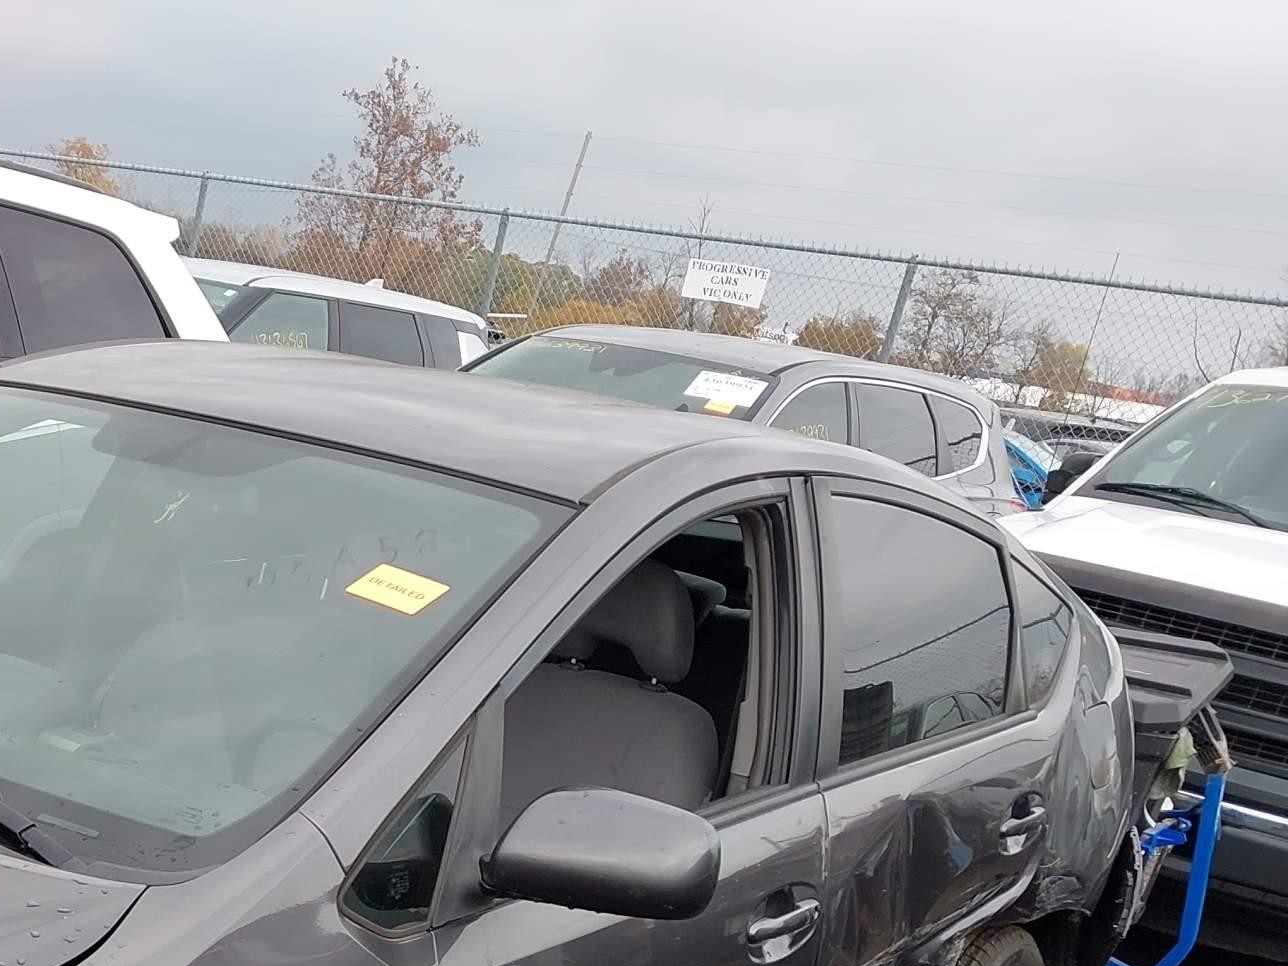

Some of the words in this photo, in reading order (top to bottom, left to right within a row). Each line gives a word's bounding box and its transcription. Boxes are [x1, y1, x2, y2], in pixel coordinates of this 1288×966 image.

[691, 260, 768, 281] PROGRESSIVE
[710, 275, 739, 287] CARS
[702, 287, 722, 298] VIC
[723, 289, 753, 302] ONLY
[368, 575, 426, 601] DETAILED
